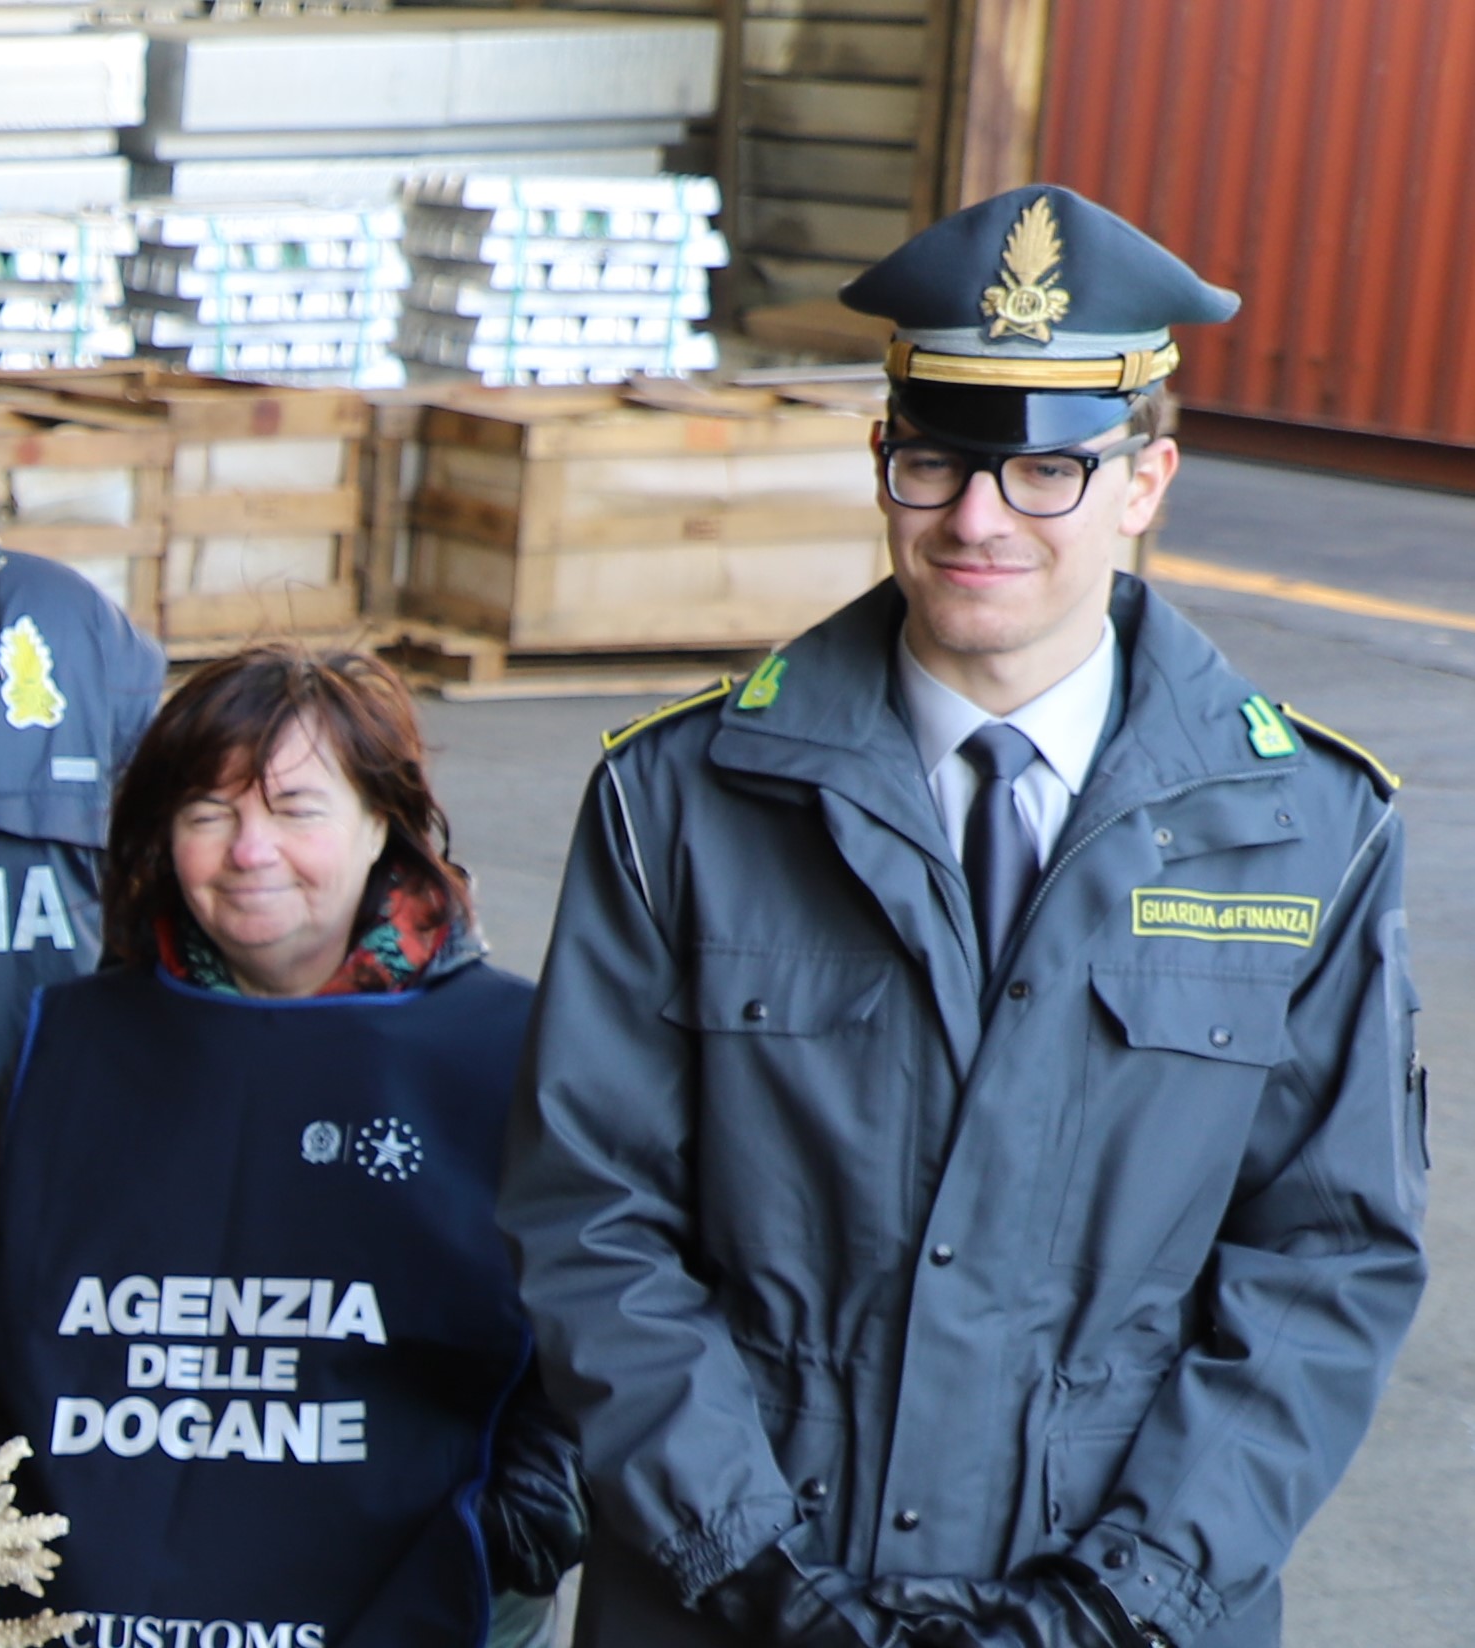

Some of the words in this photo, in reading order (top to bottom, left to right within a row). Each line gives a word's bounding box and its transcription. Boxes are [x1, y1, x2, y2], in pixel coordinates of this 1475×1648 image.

[1142, 900, 1217, 928] GUARDIA
[1218, 907, 1235, 930] di
[1236, 905, 1310, 934] FINANZA
[58, 1275, 387, 1345] AGENZIA
[127, 1343, 300, 1391] DELLE
[51, 1396, 367, 1463] DOGANE
